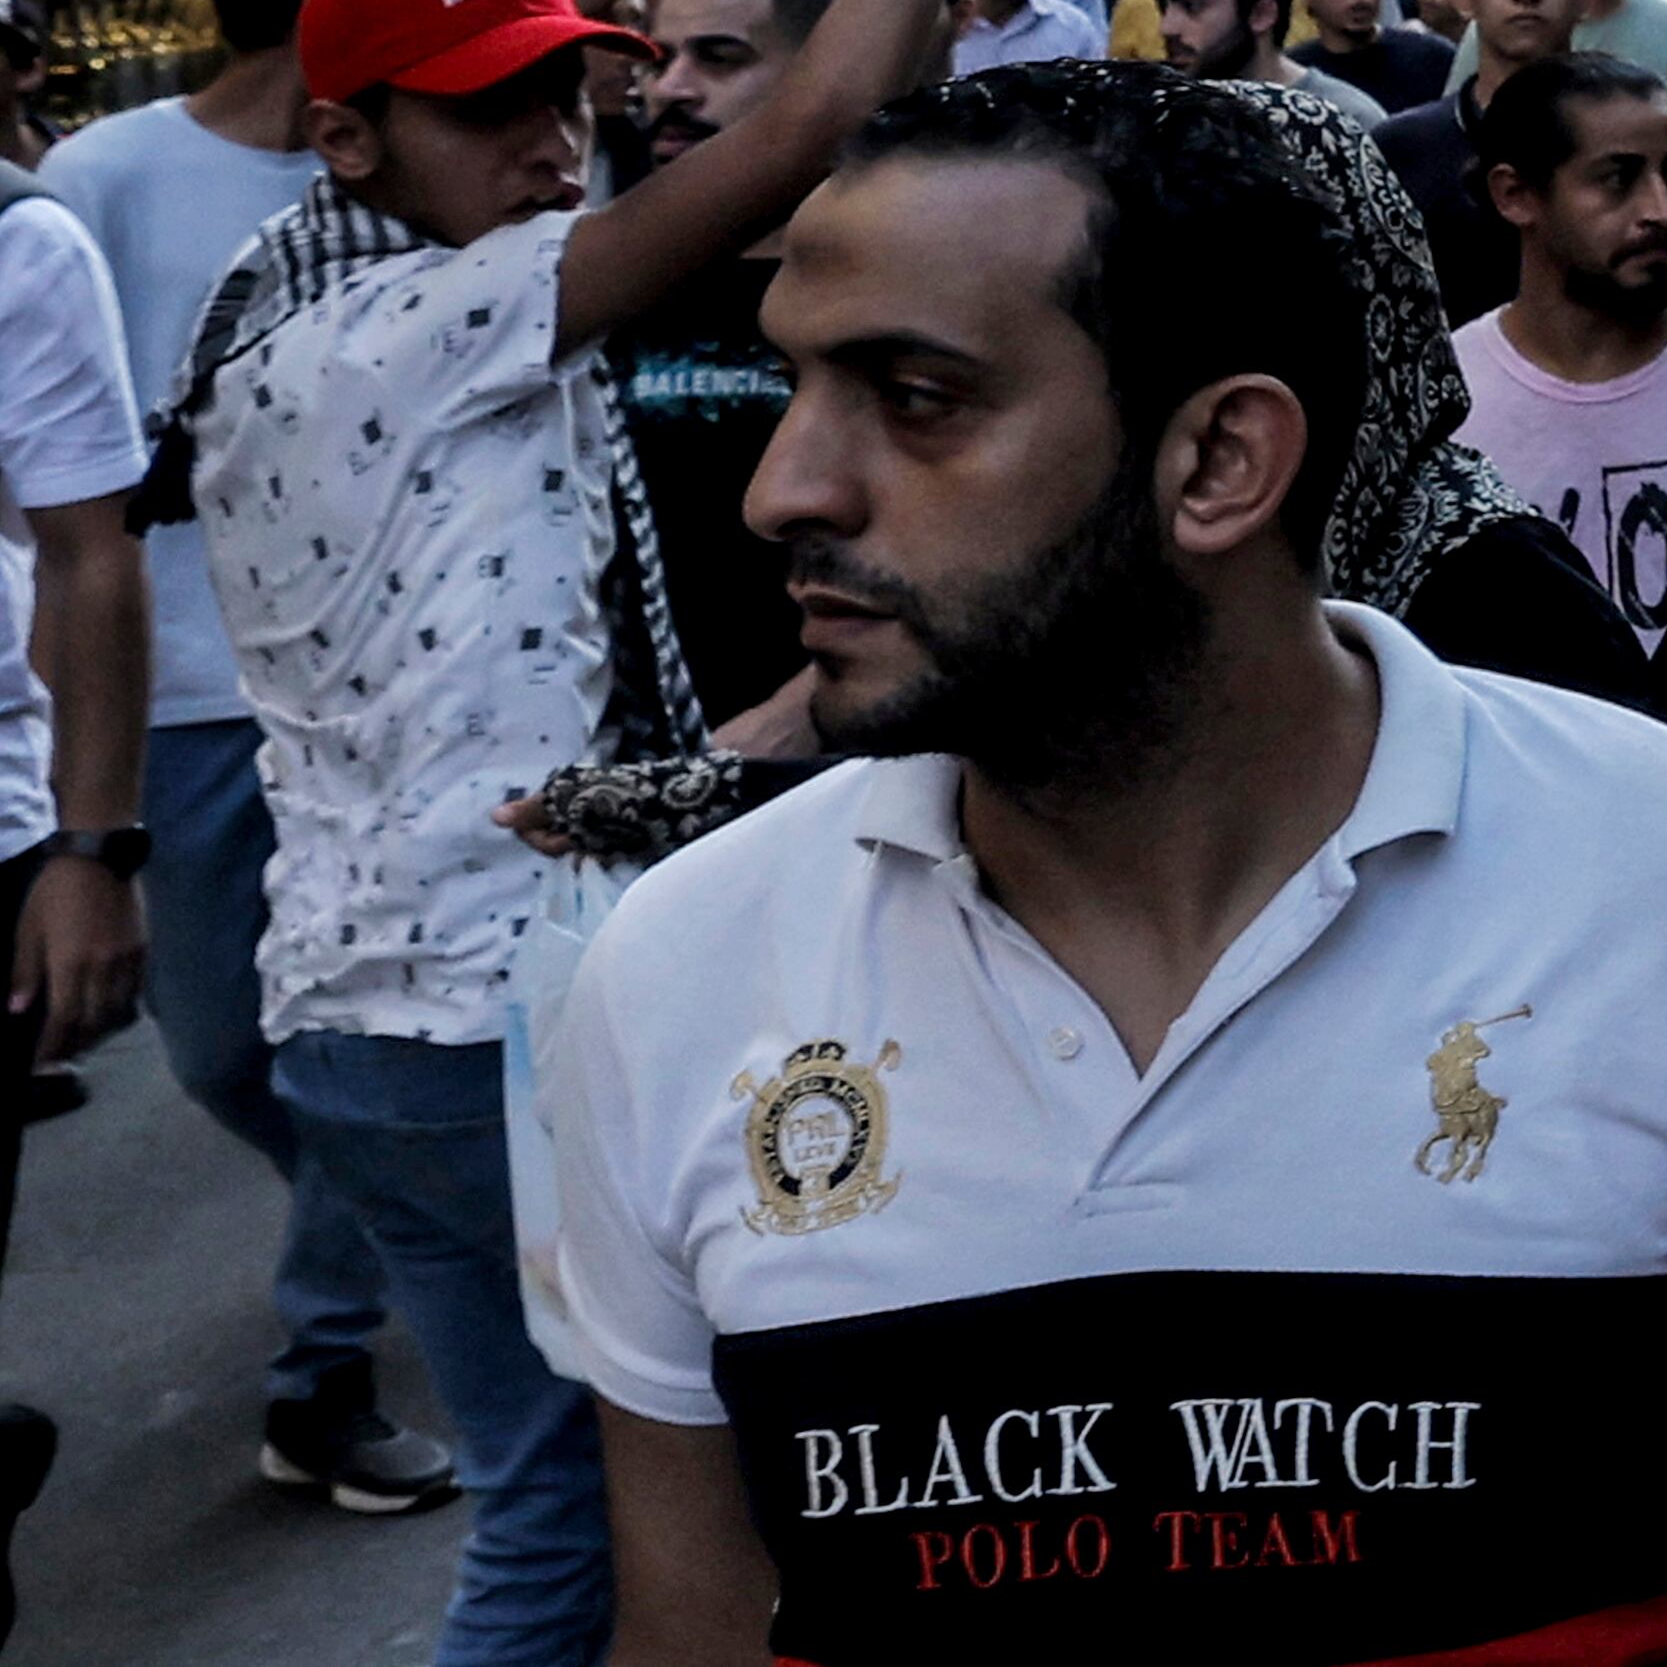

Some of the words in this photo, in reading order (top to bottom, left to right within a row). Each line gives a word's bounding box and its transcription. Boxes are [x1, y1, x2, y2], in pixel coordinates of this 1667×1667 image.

[795, 1403, 1117, 1518] BLACK
[1170, 1397, 1481, 1493] WATCH
[910, 1513, 1112, 1590] POLO
[1152, 1509, 1363, 1571] TEAM
